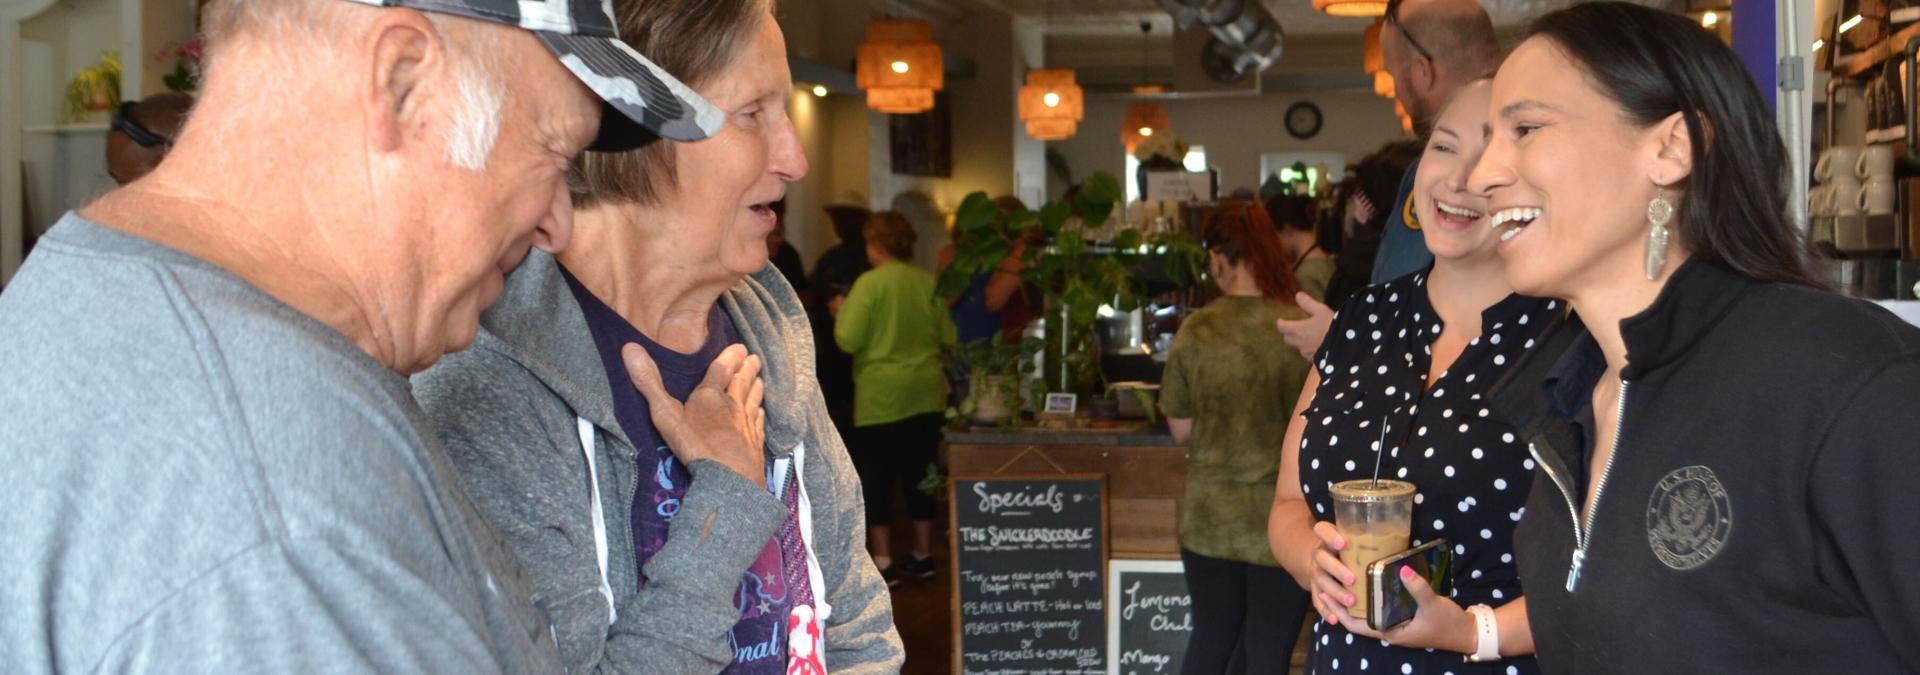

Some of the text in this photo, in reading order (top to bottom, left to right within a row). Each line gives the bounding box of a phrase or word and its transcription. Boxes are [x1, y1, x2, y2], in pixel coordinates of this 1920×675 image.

[973, 482, 1063, 514] Specials
[960, 526, 985, 542] THE
[961, 570, 987, 593] Try
[963, 601, 1003, 615] PEACH
[964, 621, 999, 635] PEACH
[1122, 648, 1170, 672] Mango
